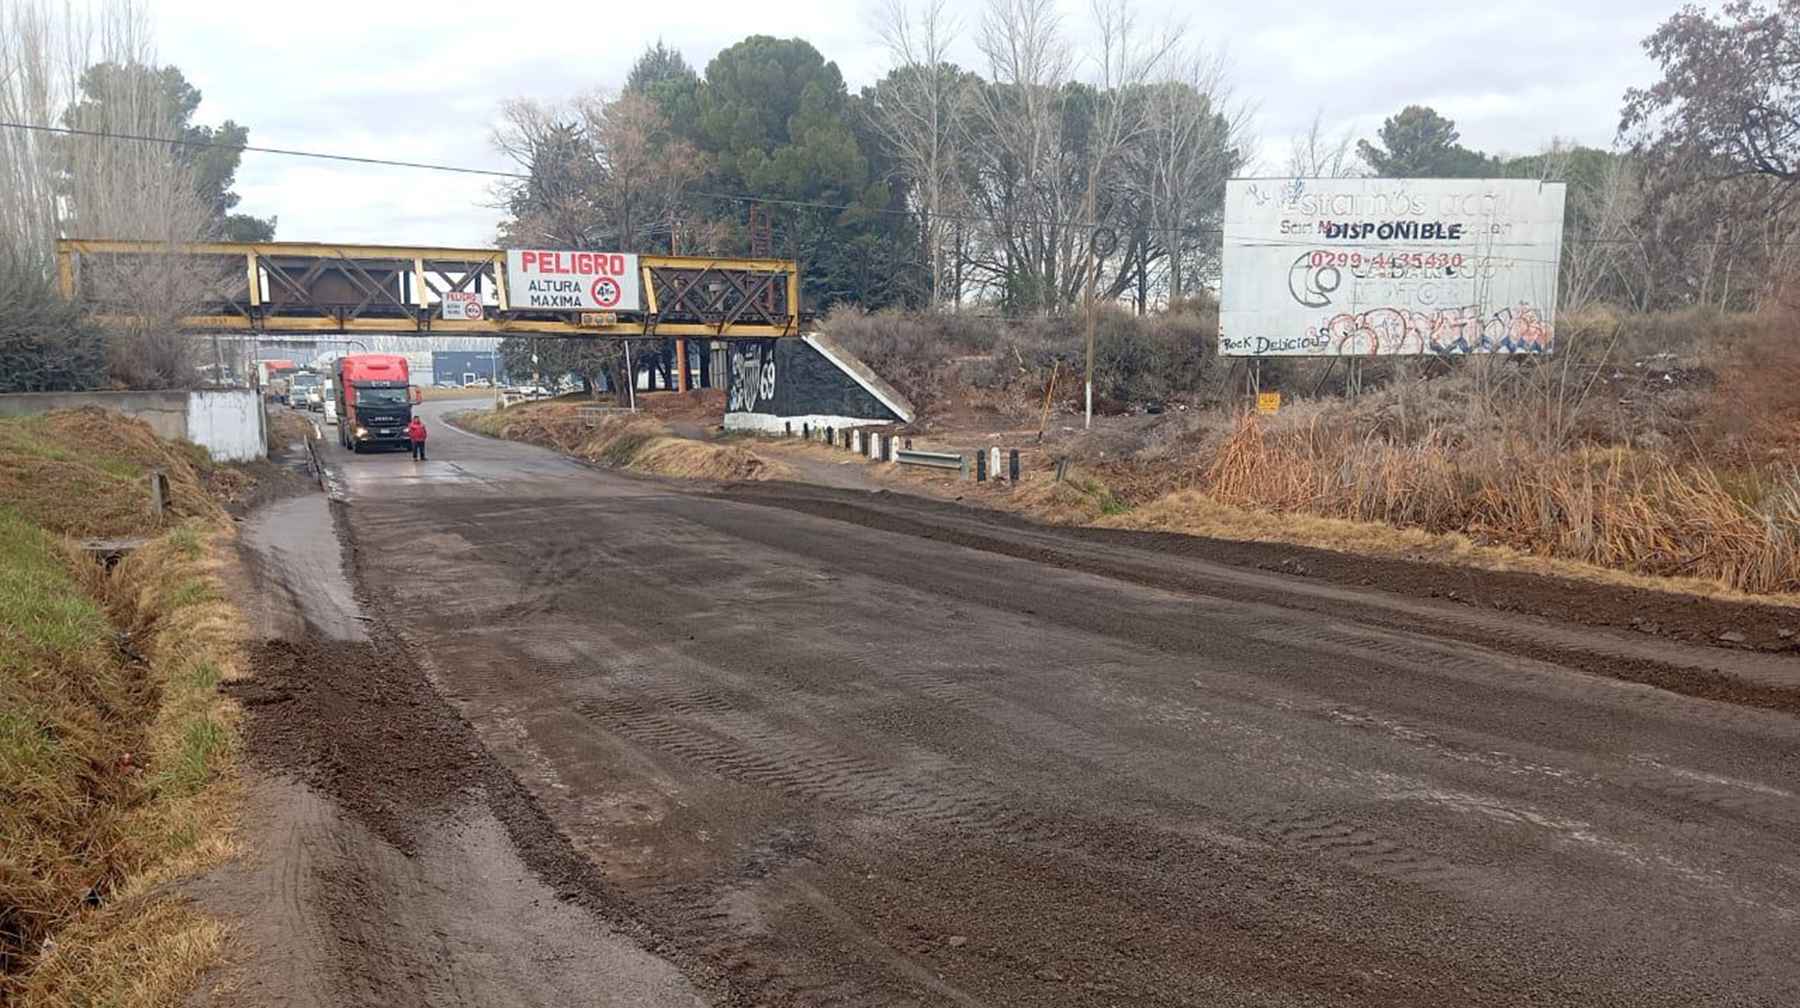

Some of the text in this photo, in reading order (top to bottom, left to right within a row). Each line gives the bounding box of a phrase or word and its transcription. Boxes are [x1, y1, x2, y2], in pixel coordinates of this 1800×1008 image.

[1325, 221, 1463, 240] DISPONIBLE
[521, 251, 625, 275] PELIGRO
[528, 280, 582, 293] ALTURA
[530, 295, 583, 307] MAXIMA
[760, 361, 776, 400] 69
